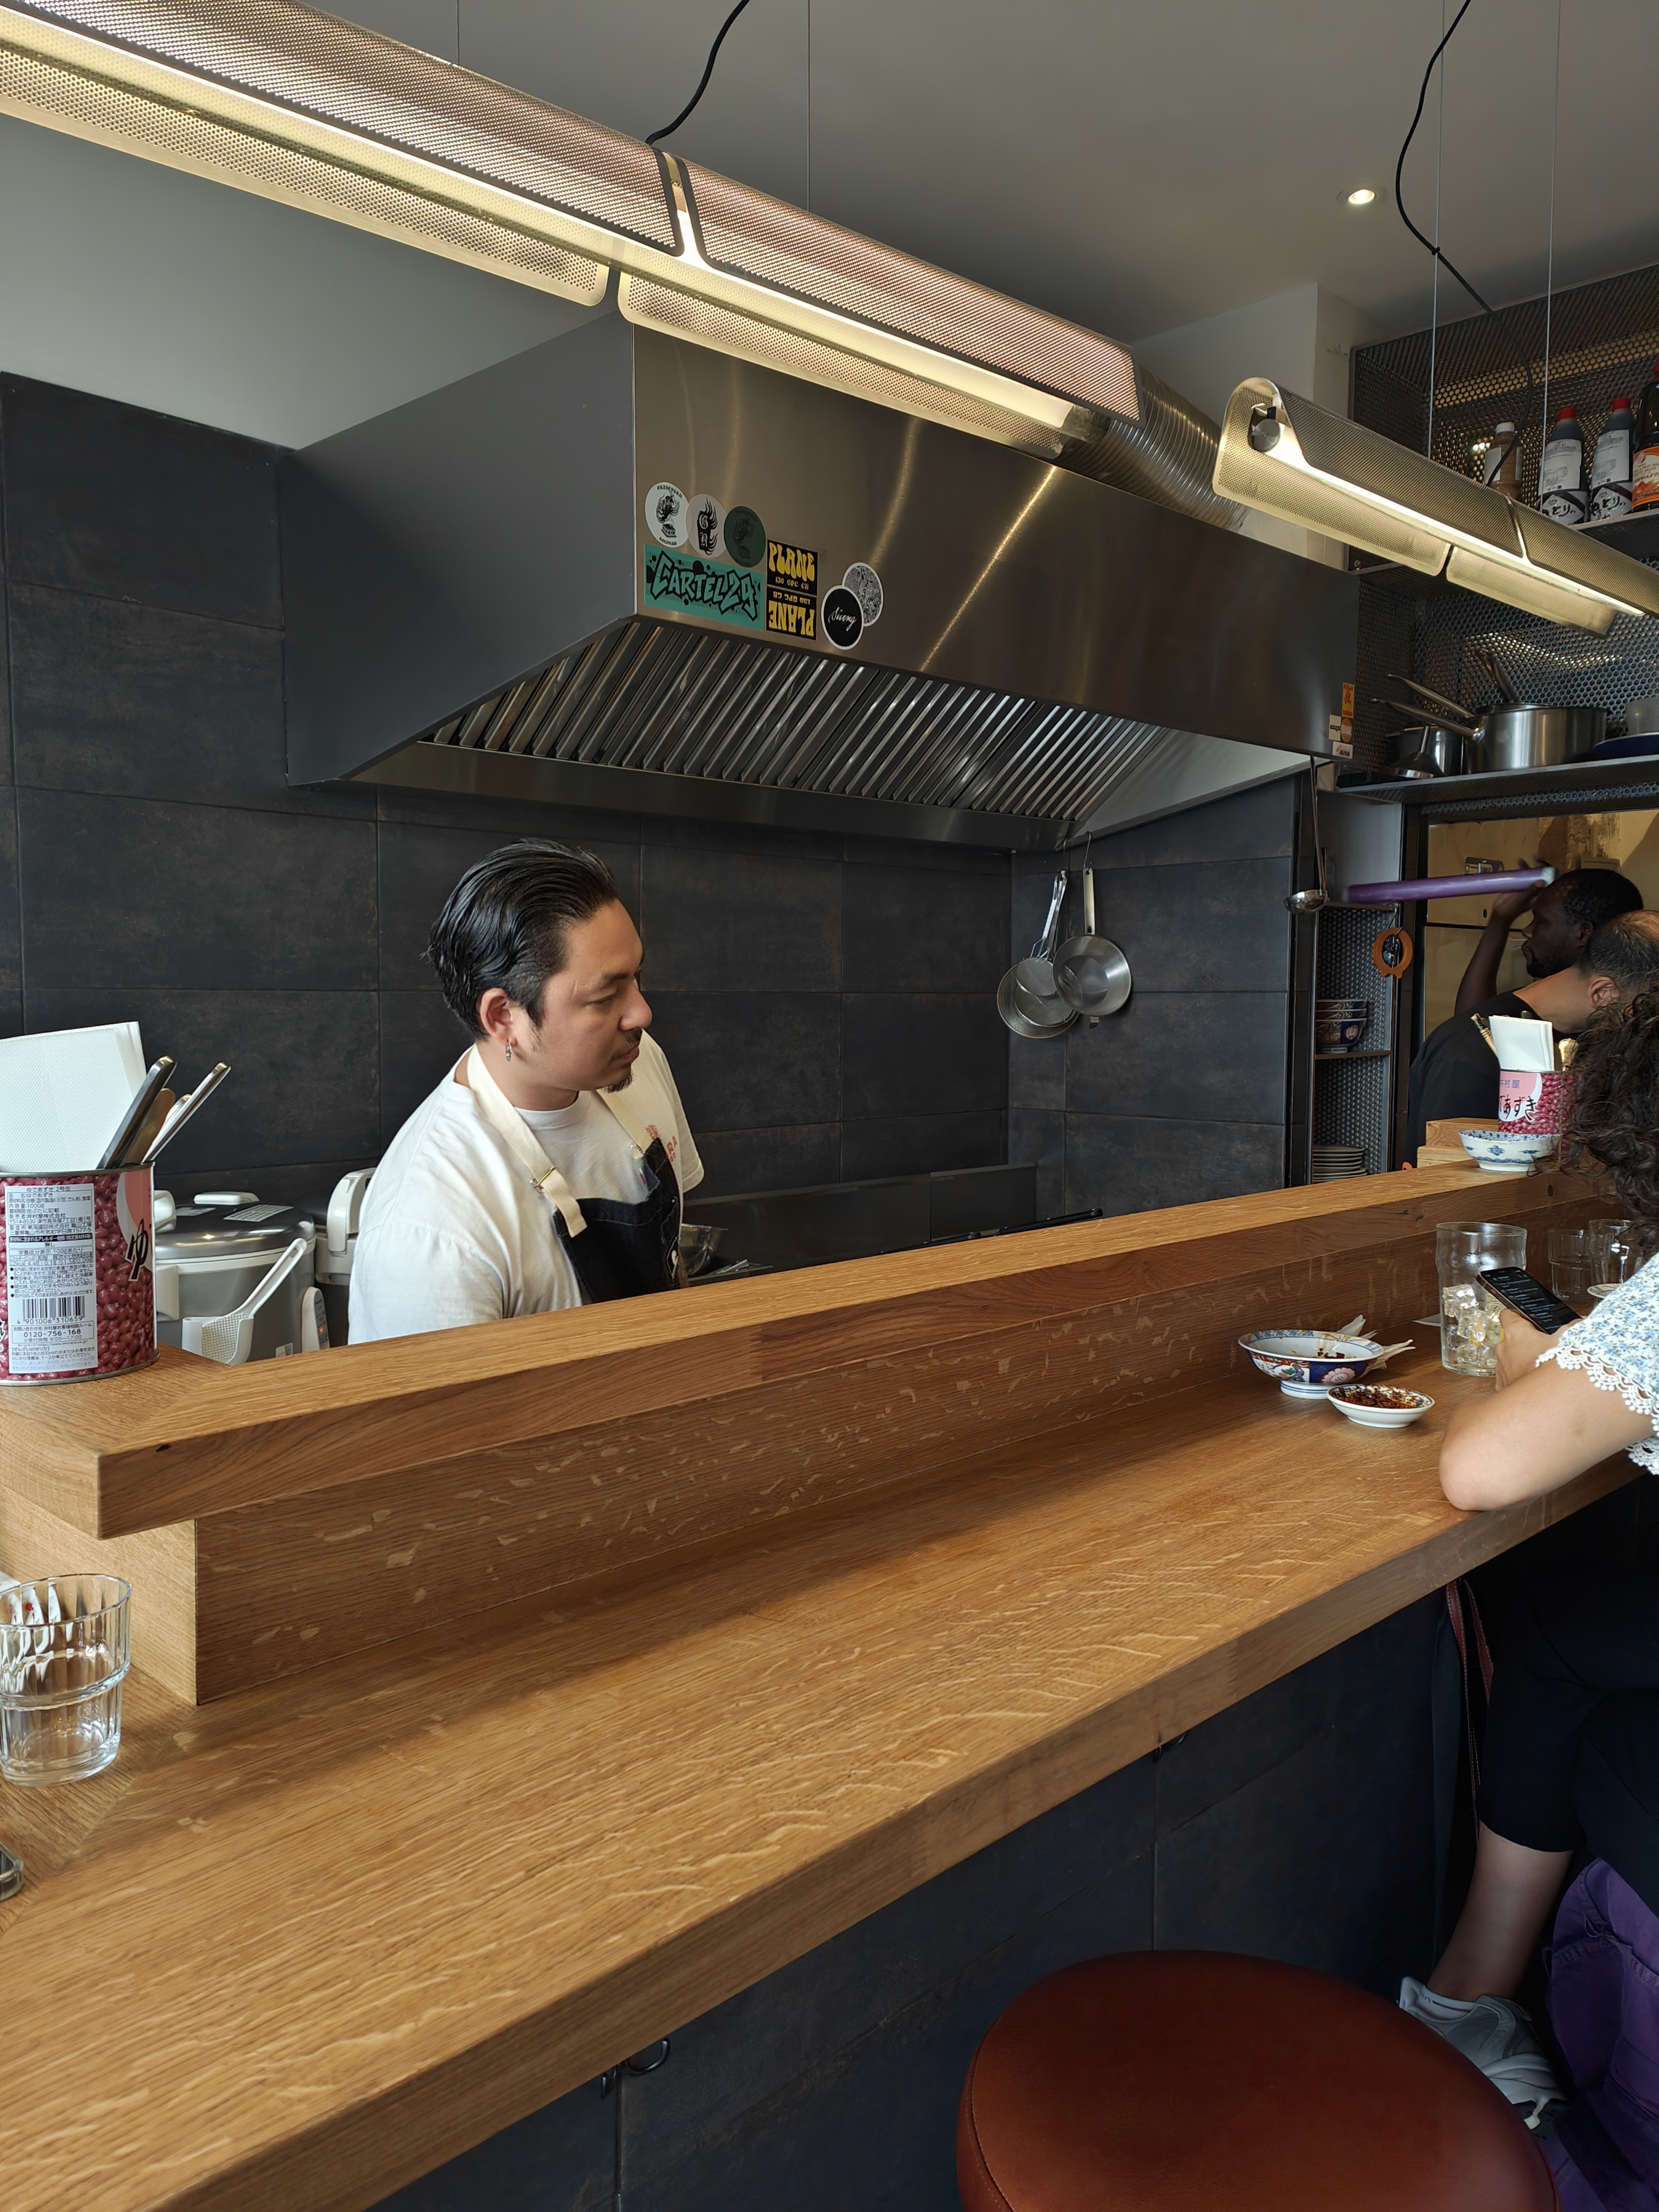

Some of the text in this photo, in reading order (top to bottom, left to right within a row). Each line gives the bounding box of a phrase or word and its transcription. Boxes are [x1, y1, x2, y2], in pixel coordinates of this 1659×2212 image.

[768, 542, 815, 582] PLANE
[775, 576, 784, 584] 130
[787, 578, 799, 588] OPC
[768, 599, 815, 637] PLANE
[24, 1328, 81, 1338] 0120-756-168
